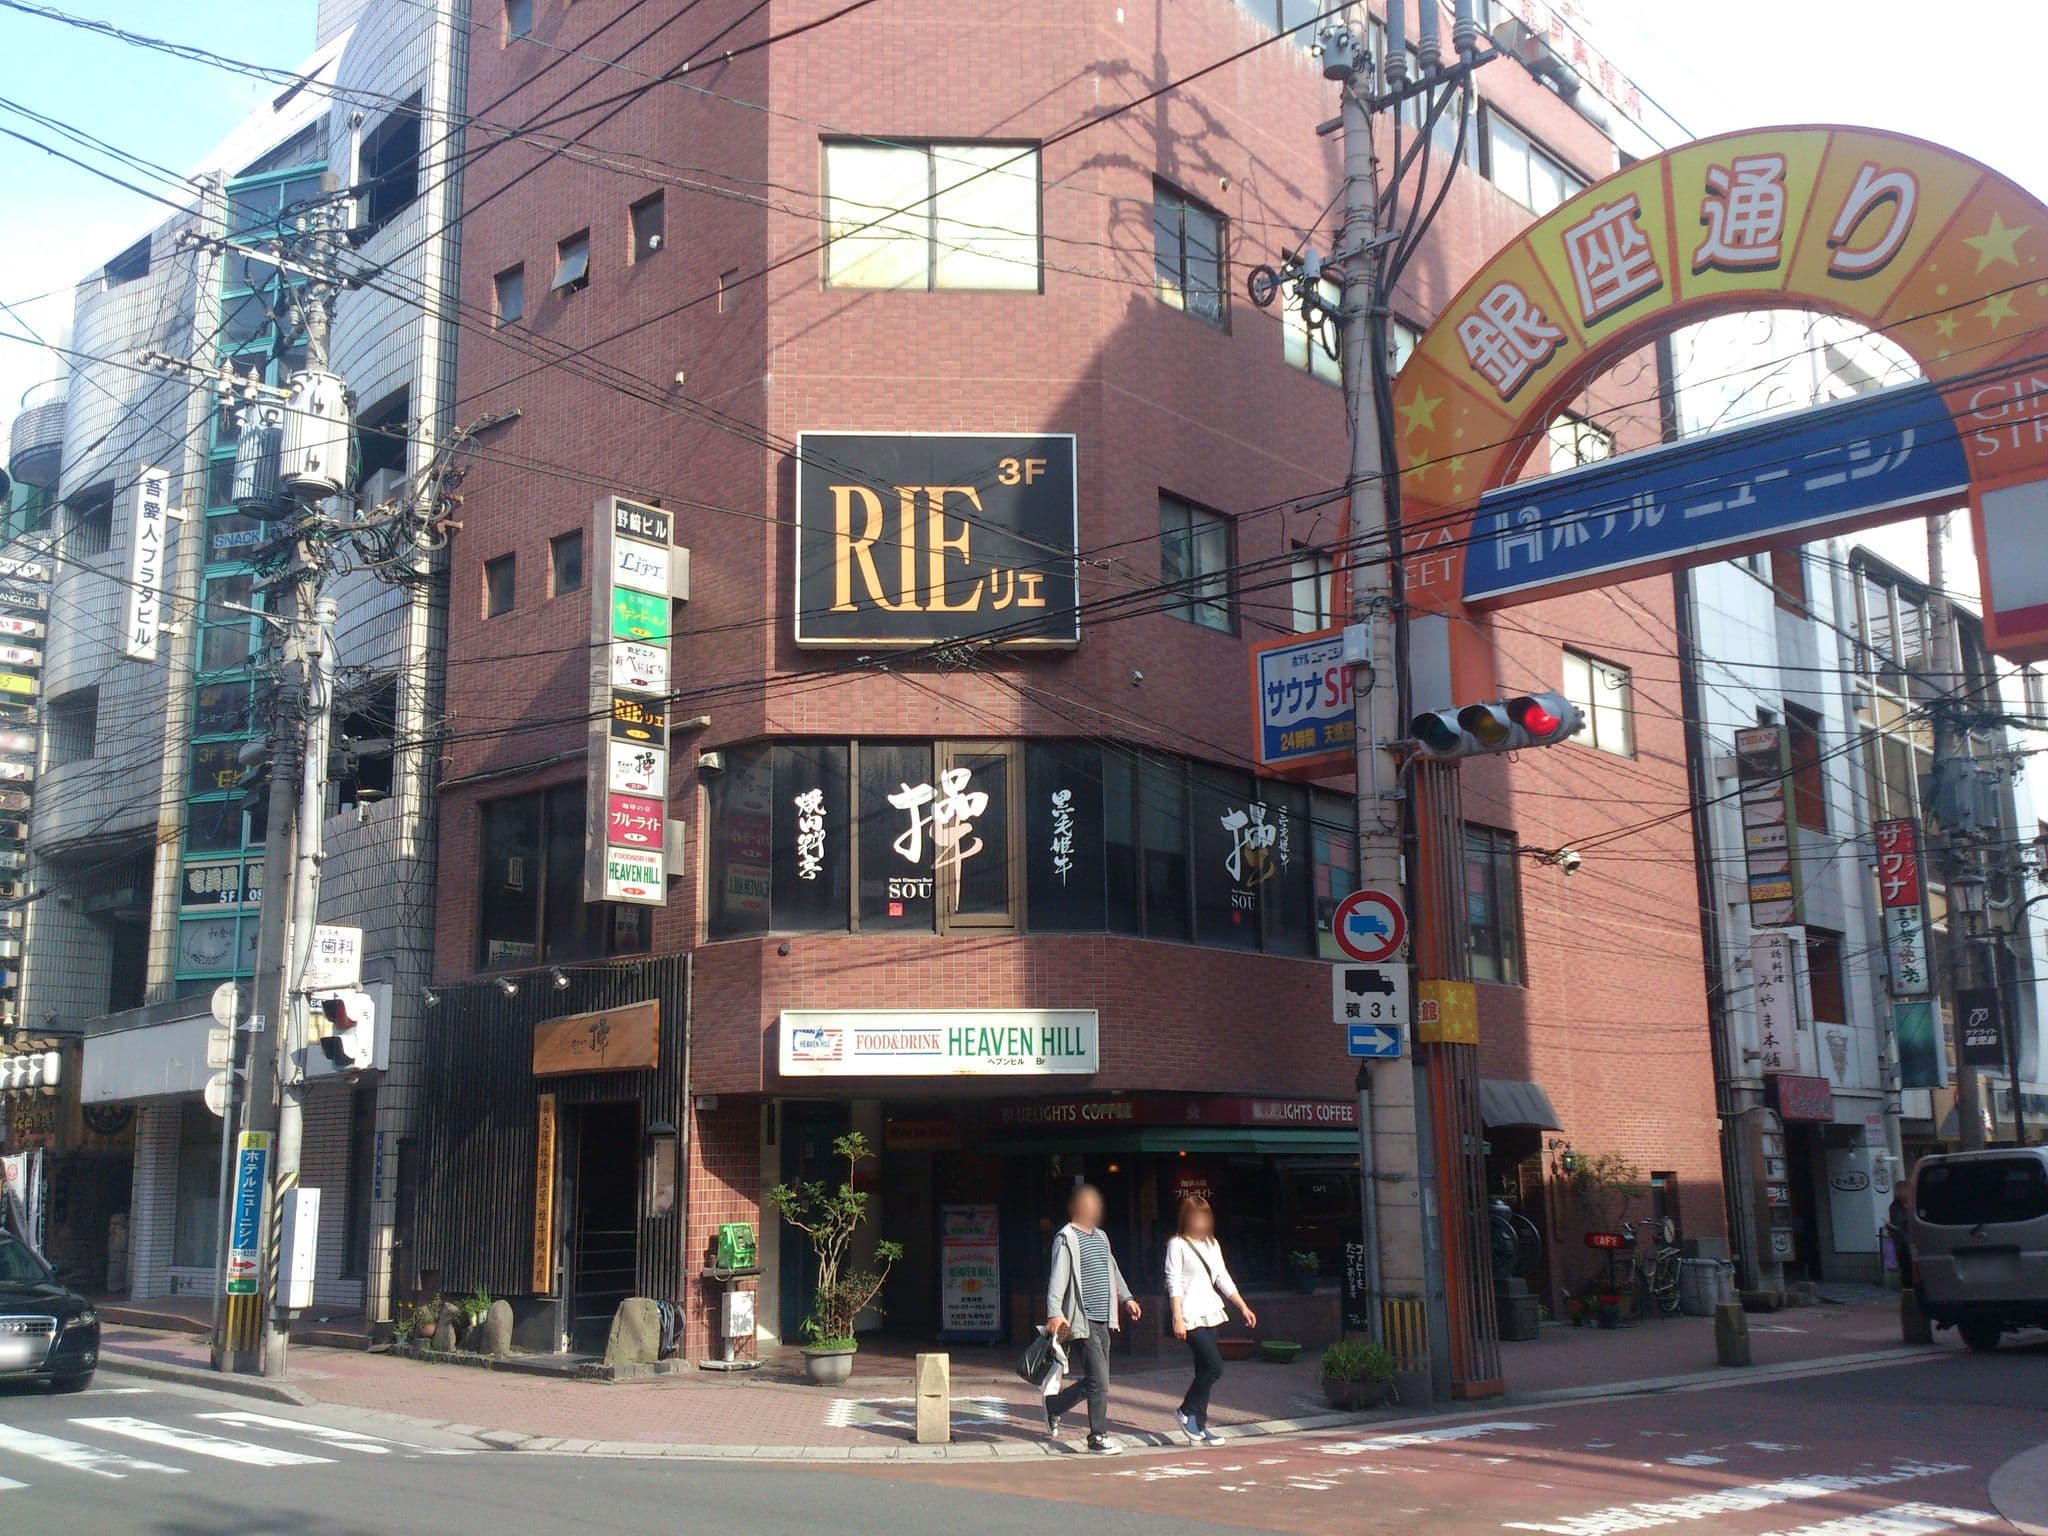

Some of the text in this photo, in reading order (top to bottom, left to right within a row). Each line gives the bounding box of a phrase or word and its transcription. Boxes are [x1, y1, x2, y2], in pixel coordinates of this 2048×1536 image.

[1457, 155, 1918, 401] 銀座通り
[998, 457, 1047, 486] 3F
[215, 532, 260, 547] SNACK
[829, 485, 984, 612] RIE
[991, 568, 1046, 610] リエ
[1267, 671, 1323, 717] サウナ
[611, 811, 661, 832] ブルーライト
[609, 861, 660, 885] HEAVEN HILL
[1878, 824, 1908, 901] サウナ
[219, 890, 236, 903] 5F
[889, 883, 933, 899] SOU
[1231, 893, 1256, 911] SOU
[1345, 1002, 1397, 1018] 積 3 t
[799, 1039, 832, 1048] HEAVEN HILL
[855, 1033, 940, 1050] FOOD&DRINK
[948, 1026, 1086, 1057] HEAVEN HILL
[987, 1057, 1025, 1066] ヘブンヒル
[1316, 1103, 1353, 1122] COFFEE
[239, 1151, 259, 1249] ホテルニューニシノ
